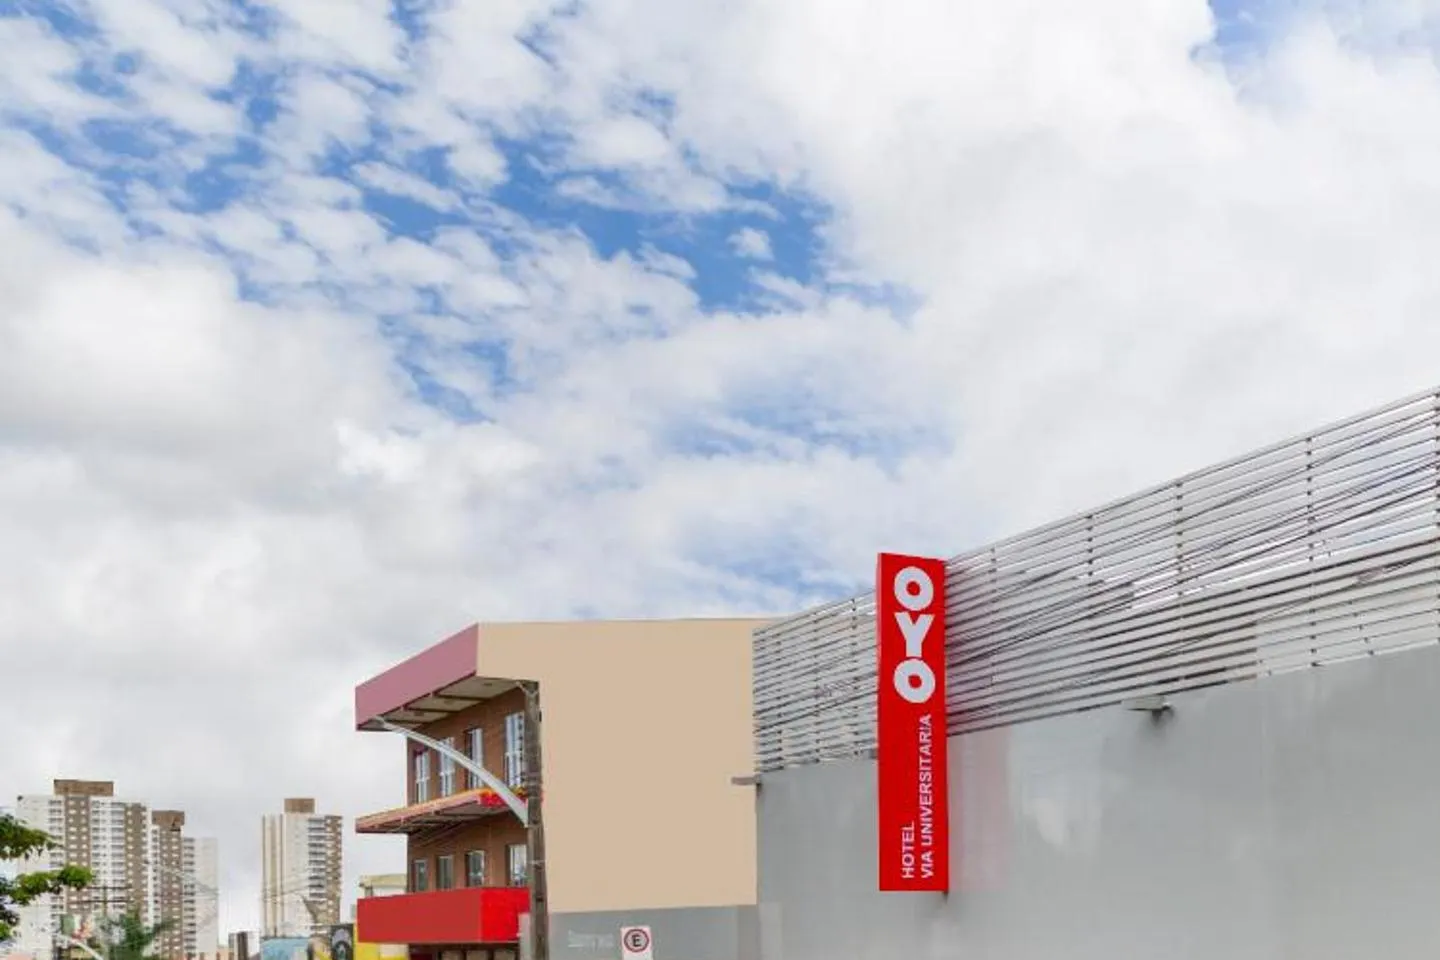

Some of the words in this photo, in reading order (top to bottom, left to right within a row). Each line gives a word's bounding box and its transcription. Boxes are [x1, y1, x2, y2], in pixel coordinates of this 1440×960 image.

[893, 566, 936, 704] OYO
[918, 713, 934, 846] UNIVERSITARIA
[901, 819, 916, 879] HOTEL
[920, 850, 935, 879] VIA
[631, 934, 642, 948] E
